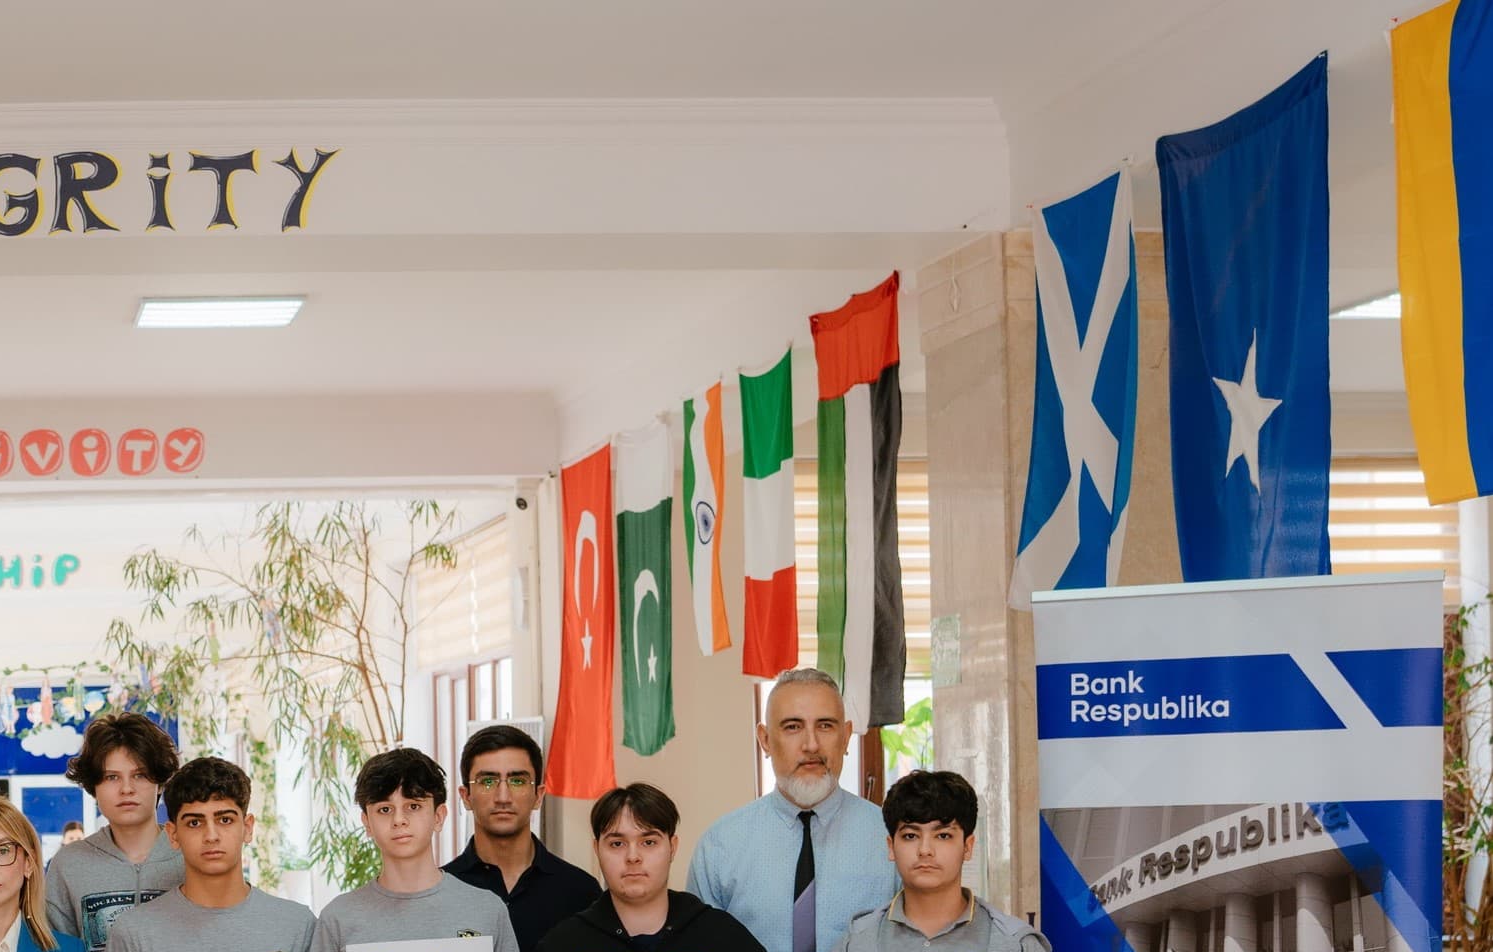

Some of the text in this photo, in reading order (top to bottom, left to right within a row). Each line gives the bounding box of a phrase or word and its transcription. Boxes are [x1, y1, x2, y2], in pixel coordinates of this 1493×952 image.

[1071, 670, 1144, 696] Bank
[1071, 696, 1229, 727] Respublika
[1138, 802, 1349, 888] Respublika
